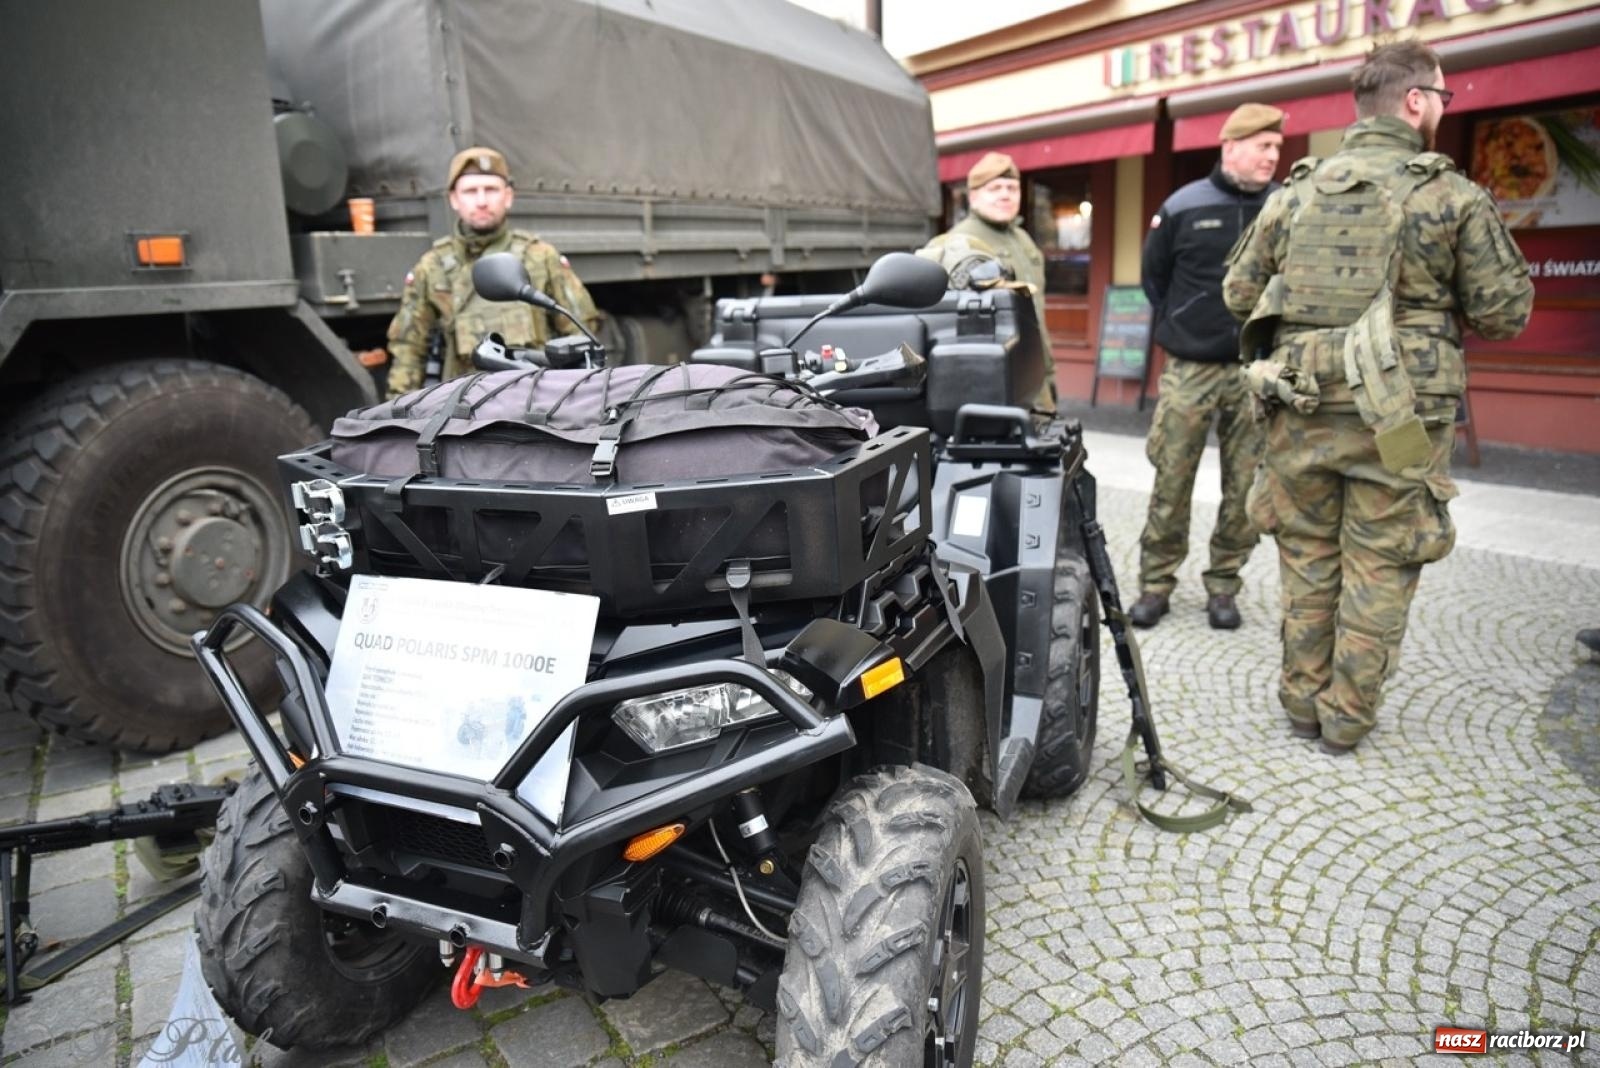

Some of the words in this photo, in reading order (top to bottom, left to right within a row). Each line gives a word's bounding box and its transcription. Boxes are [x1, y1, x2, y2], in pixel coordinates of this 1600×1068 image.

[354, 631, 393, 651] QUAD
[396, 637, 458, 661] POLARIS
[461, 645, 497, 667] SPM
[502, 651, 557, 675] 1000E
